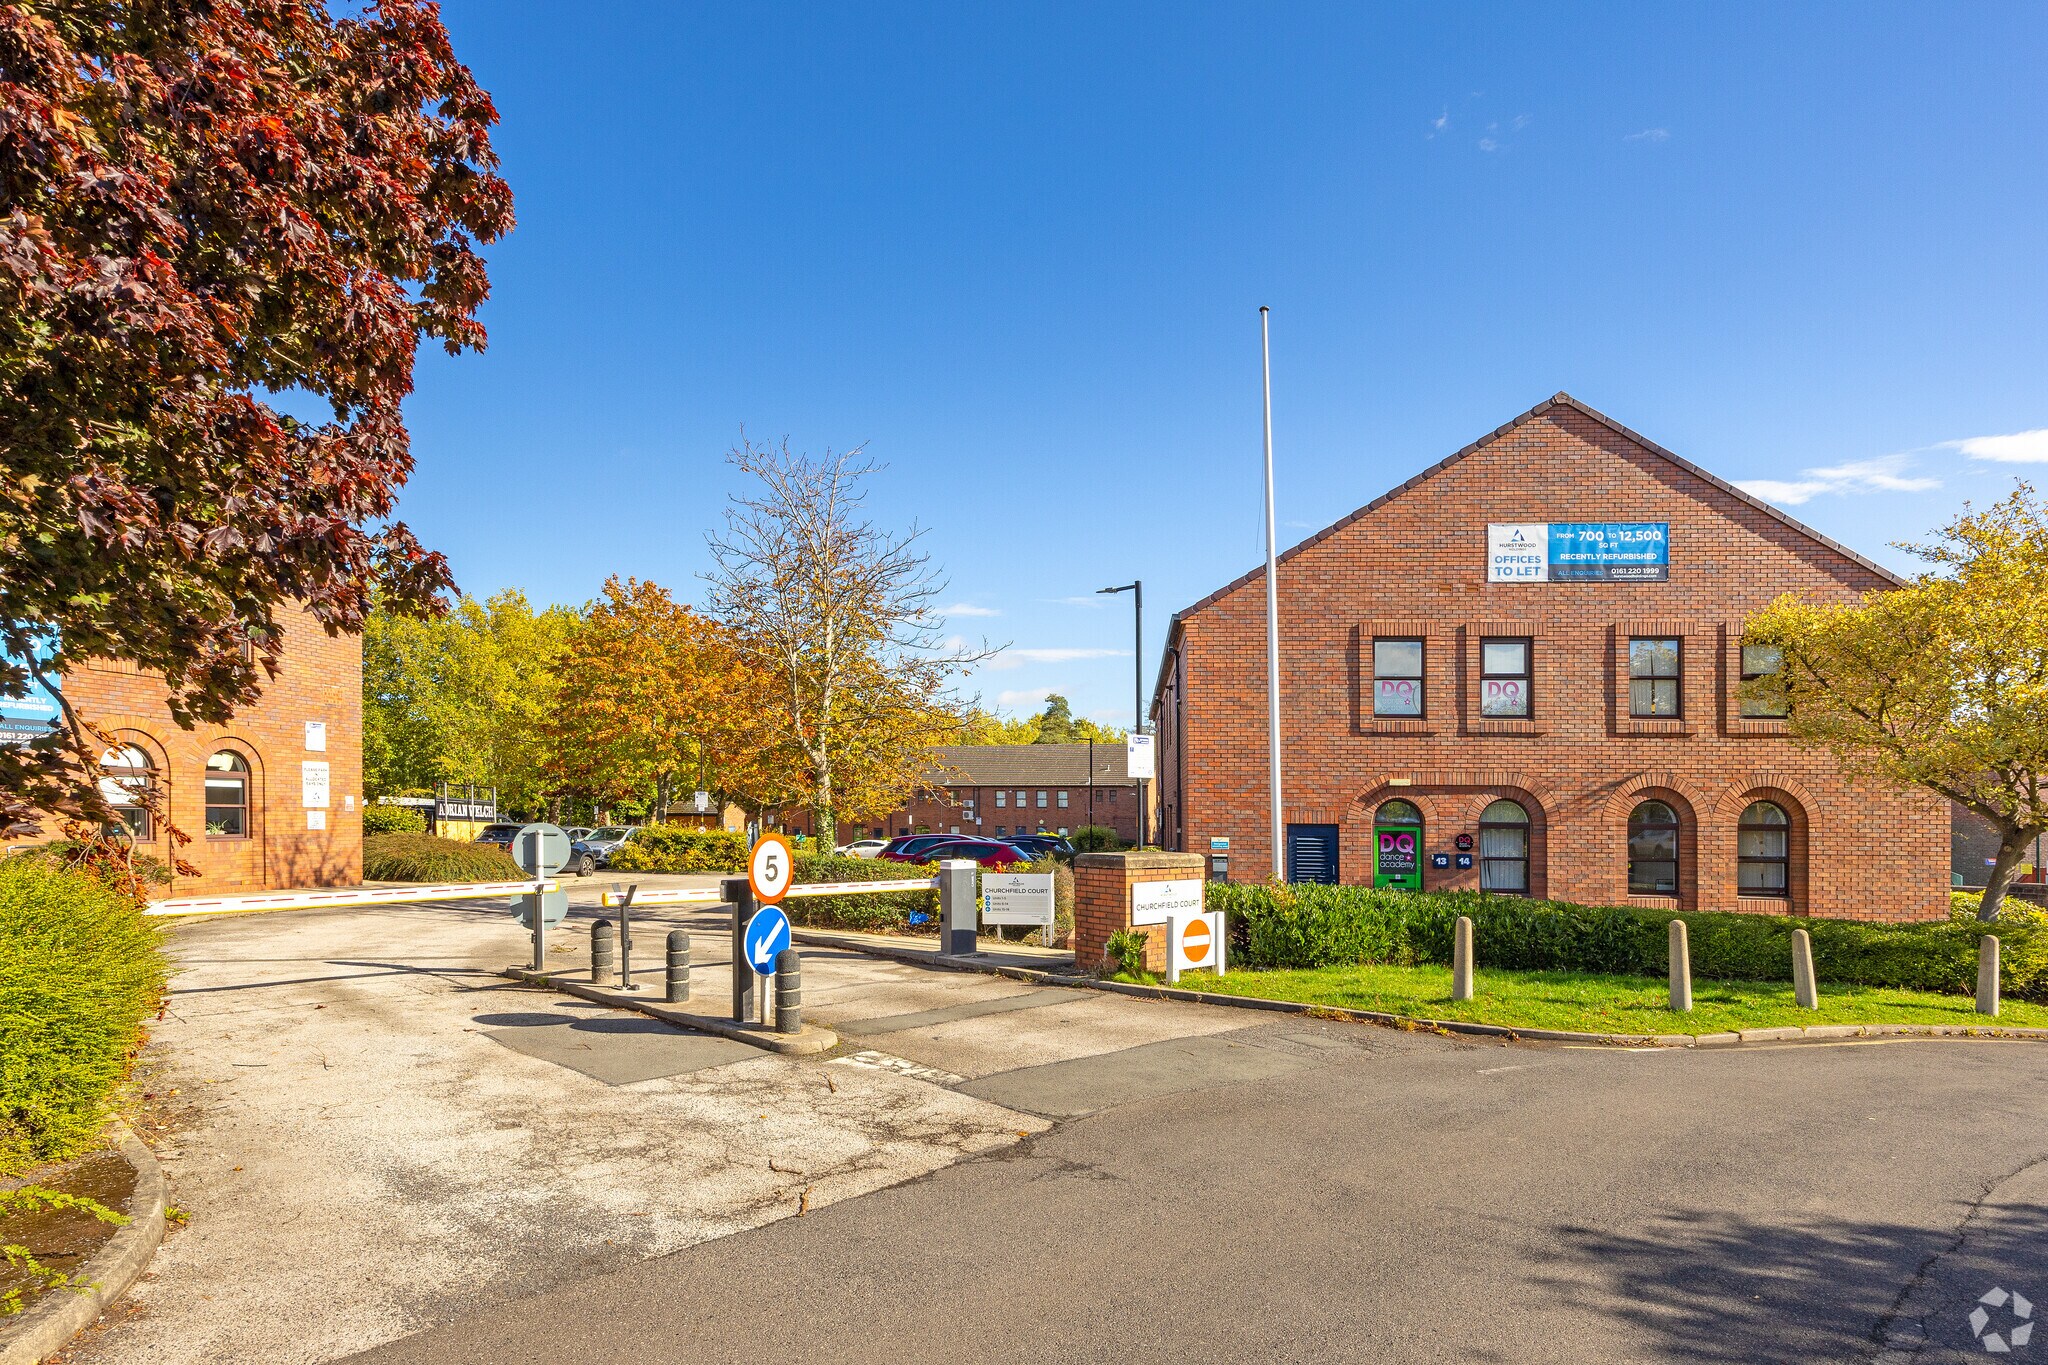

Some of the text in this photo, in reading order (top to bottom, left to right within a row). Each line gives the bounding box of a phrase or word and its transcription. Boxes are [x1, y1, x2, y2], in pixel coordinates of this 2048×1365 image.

[1578, 531, 1604, 542] 700
[1618, 530, 1662, 543] 12,500
[1494, 556, 1542, 564] OFFICES
[1495, 566, 1541, 576] TO LET
[1382, 680, 1412, 698] DQ
[1488, 681, 1519, 698] DQ
[438, 803, 494, 818] ADRIAN WELCH
[1380, 834, 1415, 854] DQ
[765, 855, 778, 882] 5
[1380, 860, 1415, 869] academy
[1136, 899, 1200, 911] CHURCHFIELD COURT
